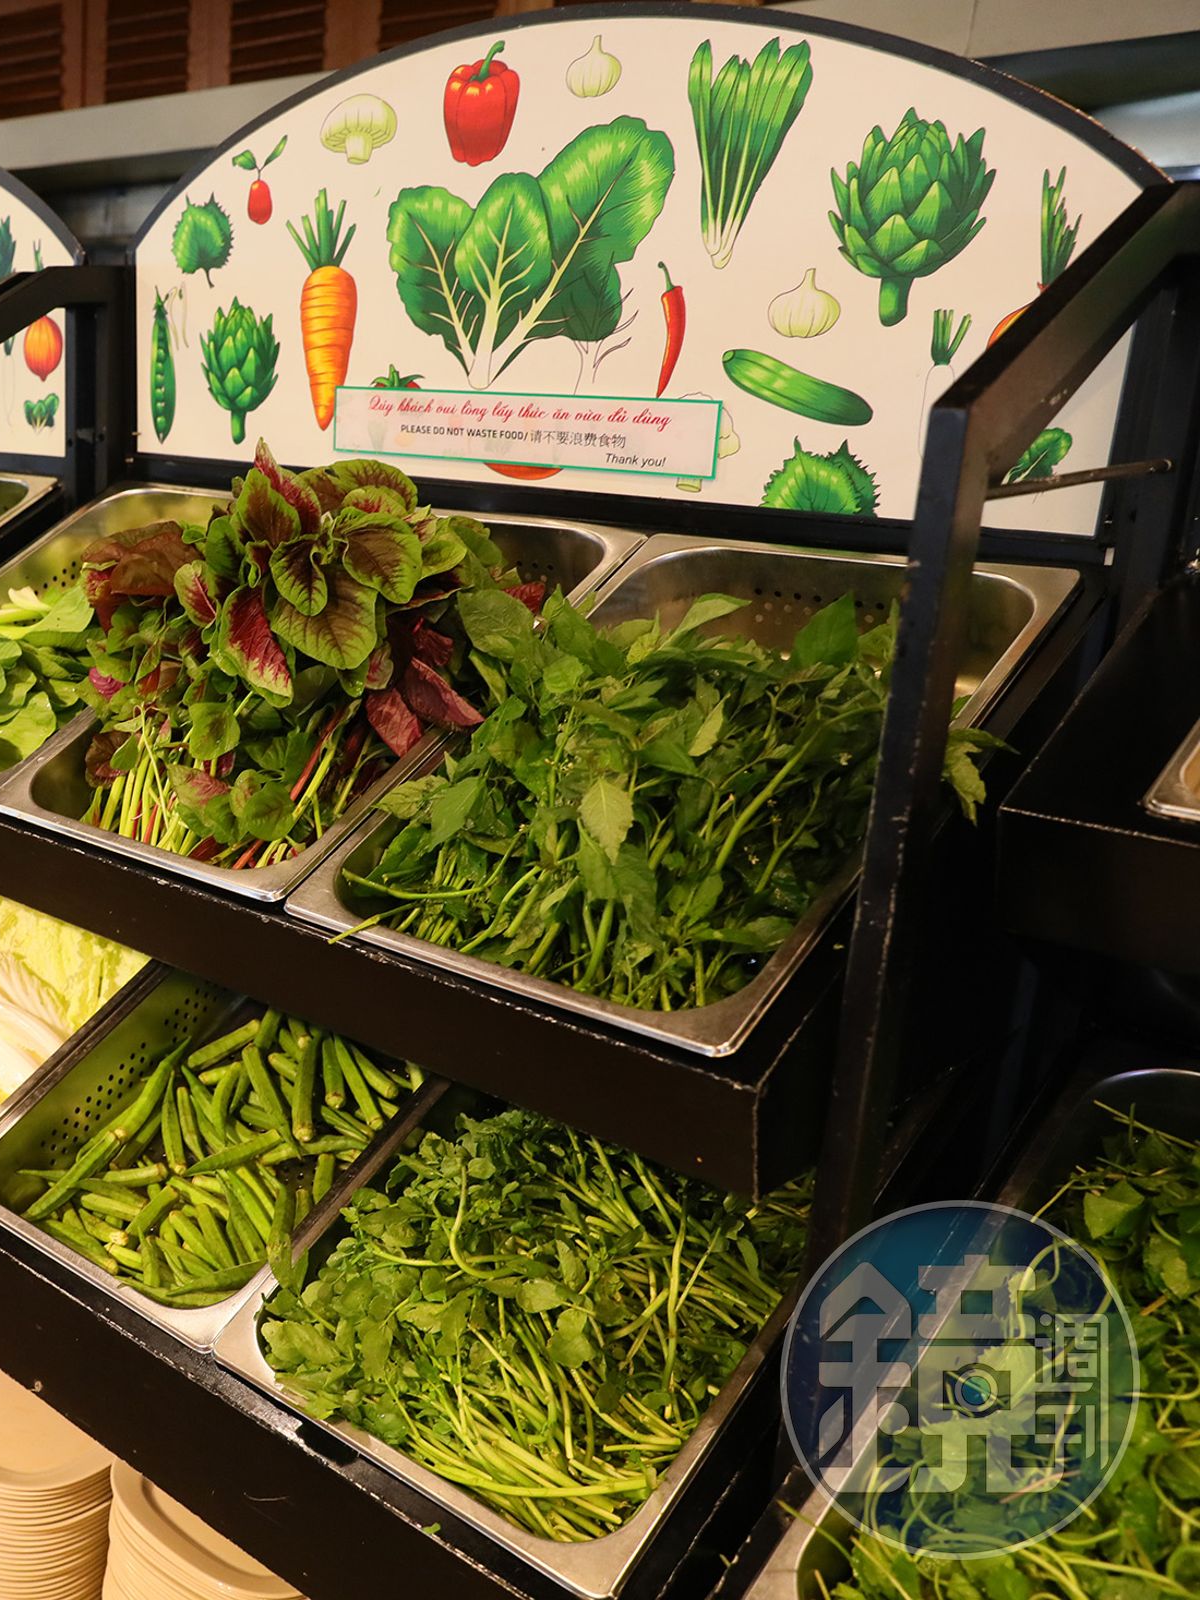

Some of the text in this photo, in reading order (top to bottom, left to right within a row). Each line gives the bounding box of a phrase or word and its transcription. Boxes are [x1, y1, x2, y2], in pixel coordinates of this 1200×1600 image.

[397, 398, 434, 414] khách
[461, 400, 488, 422] lòng
[492, 401, 513, 423] lấy
[518, 403, 549, 418] thức
[552, 408, 570, 421] ăn
[607, 407, 629, 424] đủ
[632, 408, 672, 432] dùng
[400, 424, 431, 435] PLEASE
[433, 426, 445, 436] DO
[446, 427, 464, 437] NOT
[466, 428, 497, 439] WASTE
[530, 429, 627, 449] 请不要浪费食物
[605, 452, 667, 468] Thank you!
